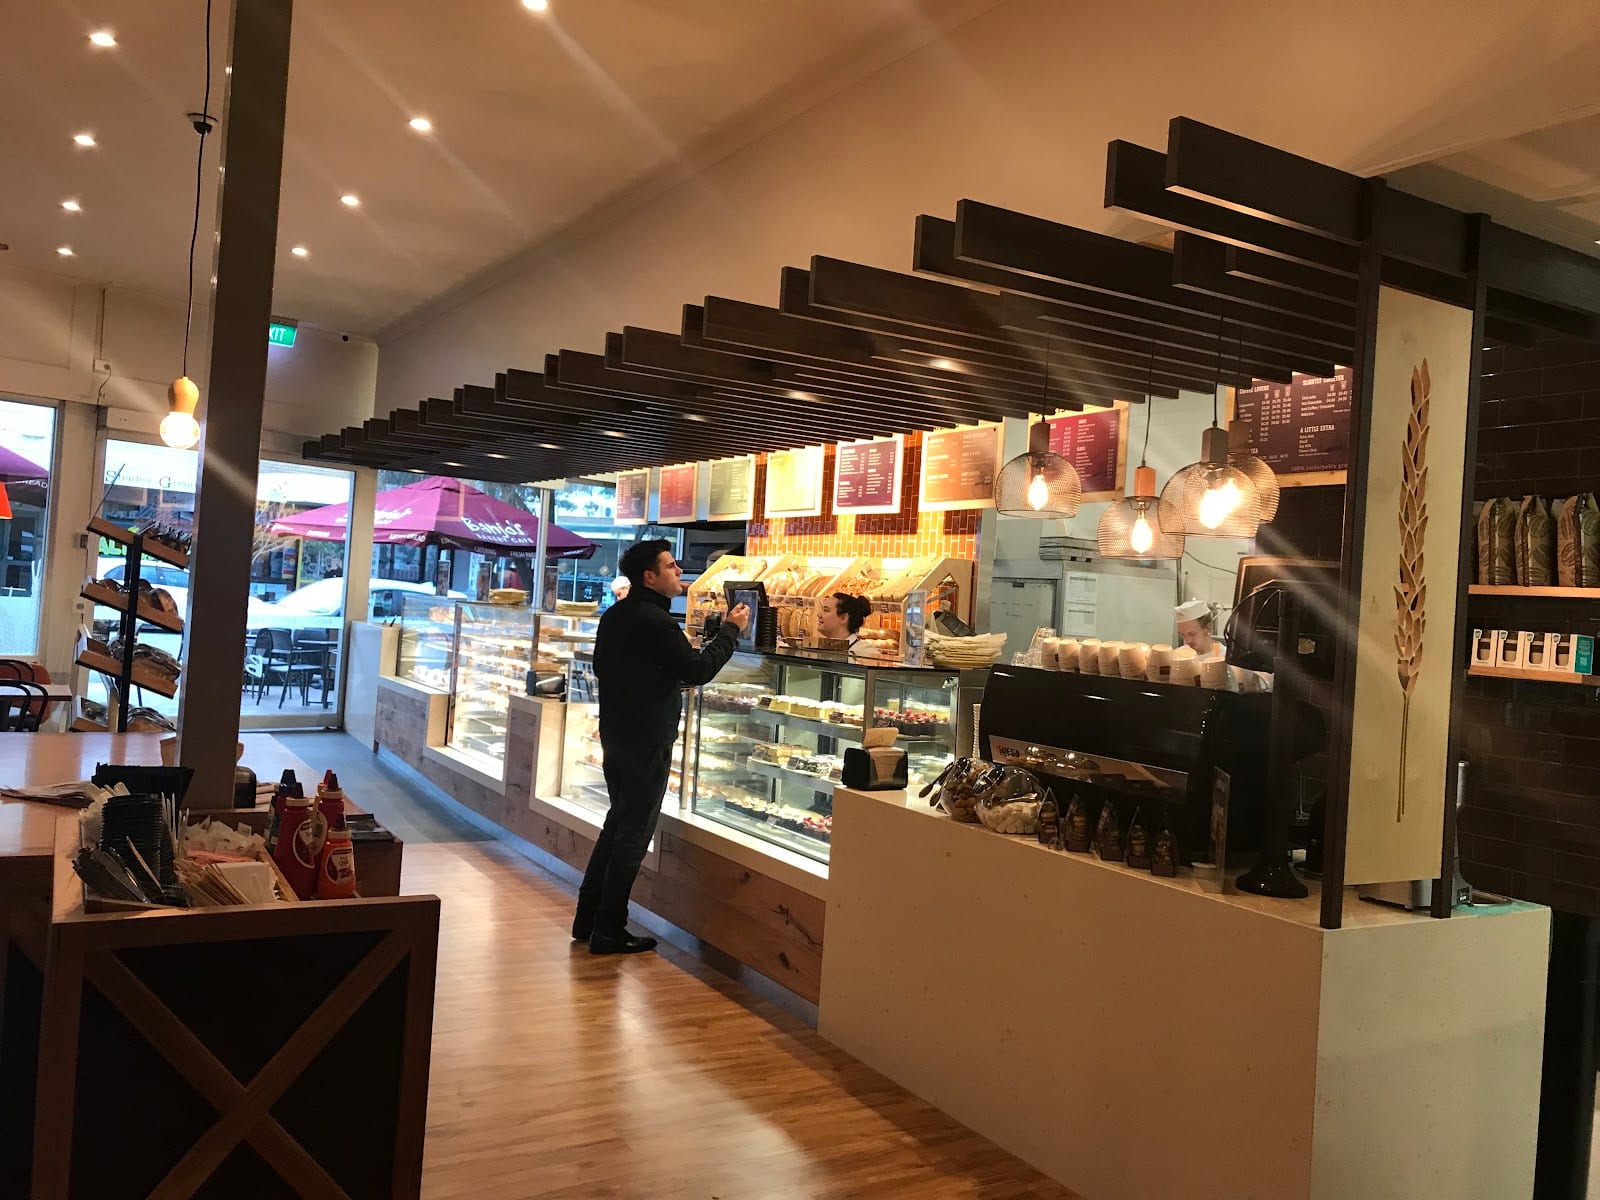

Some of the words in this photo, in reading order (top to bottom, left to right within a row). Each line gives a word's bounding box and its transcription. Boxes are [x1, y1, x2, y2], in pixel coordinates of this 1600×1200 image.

[269, 327, 287, 341] XIT
[1304, 425, 1320, 433] LITTLE
[1320, 424, 1335, 432] EXTRA
[460, 516, 525, 538] Banjo's
